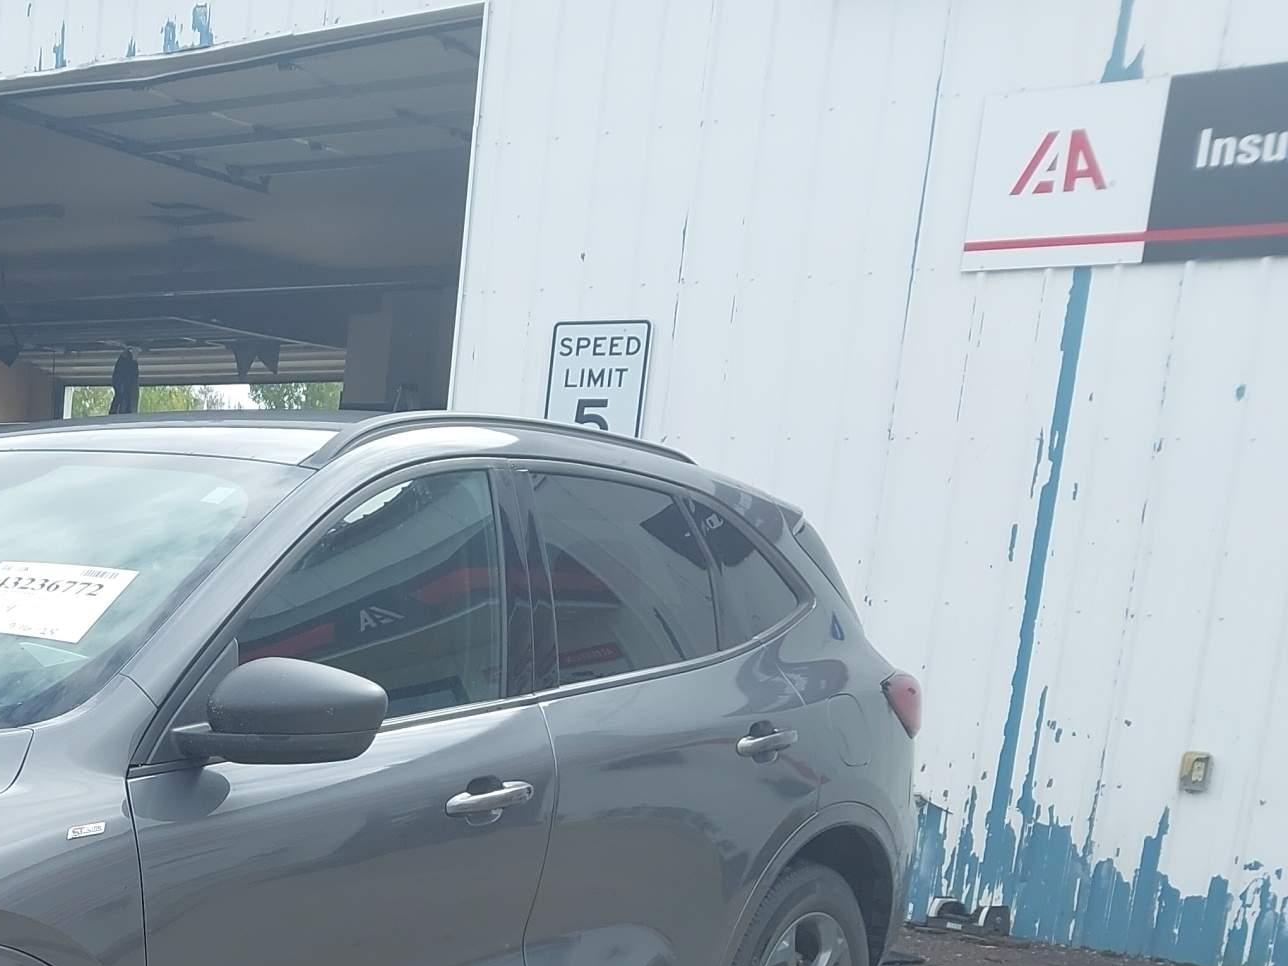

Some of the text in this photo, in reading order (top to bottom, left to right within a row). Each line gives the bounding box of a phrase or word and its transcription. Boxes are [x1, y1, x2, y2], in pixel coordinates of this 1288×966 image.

[1195, 127, 1288, 169] Insu
[559, 335, 642, 357] SPEED
[563, 367, 629, 388] LIMIT
[574, 398, 609, 431] 5
